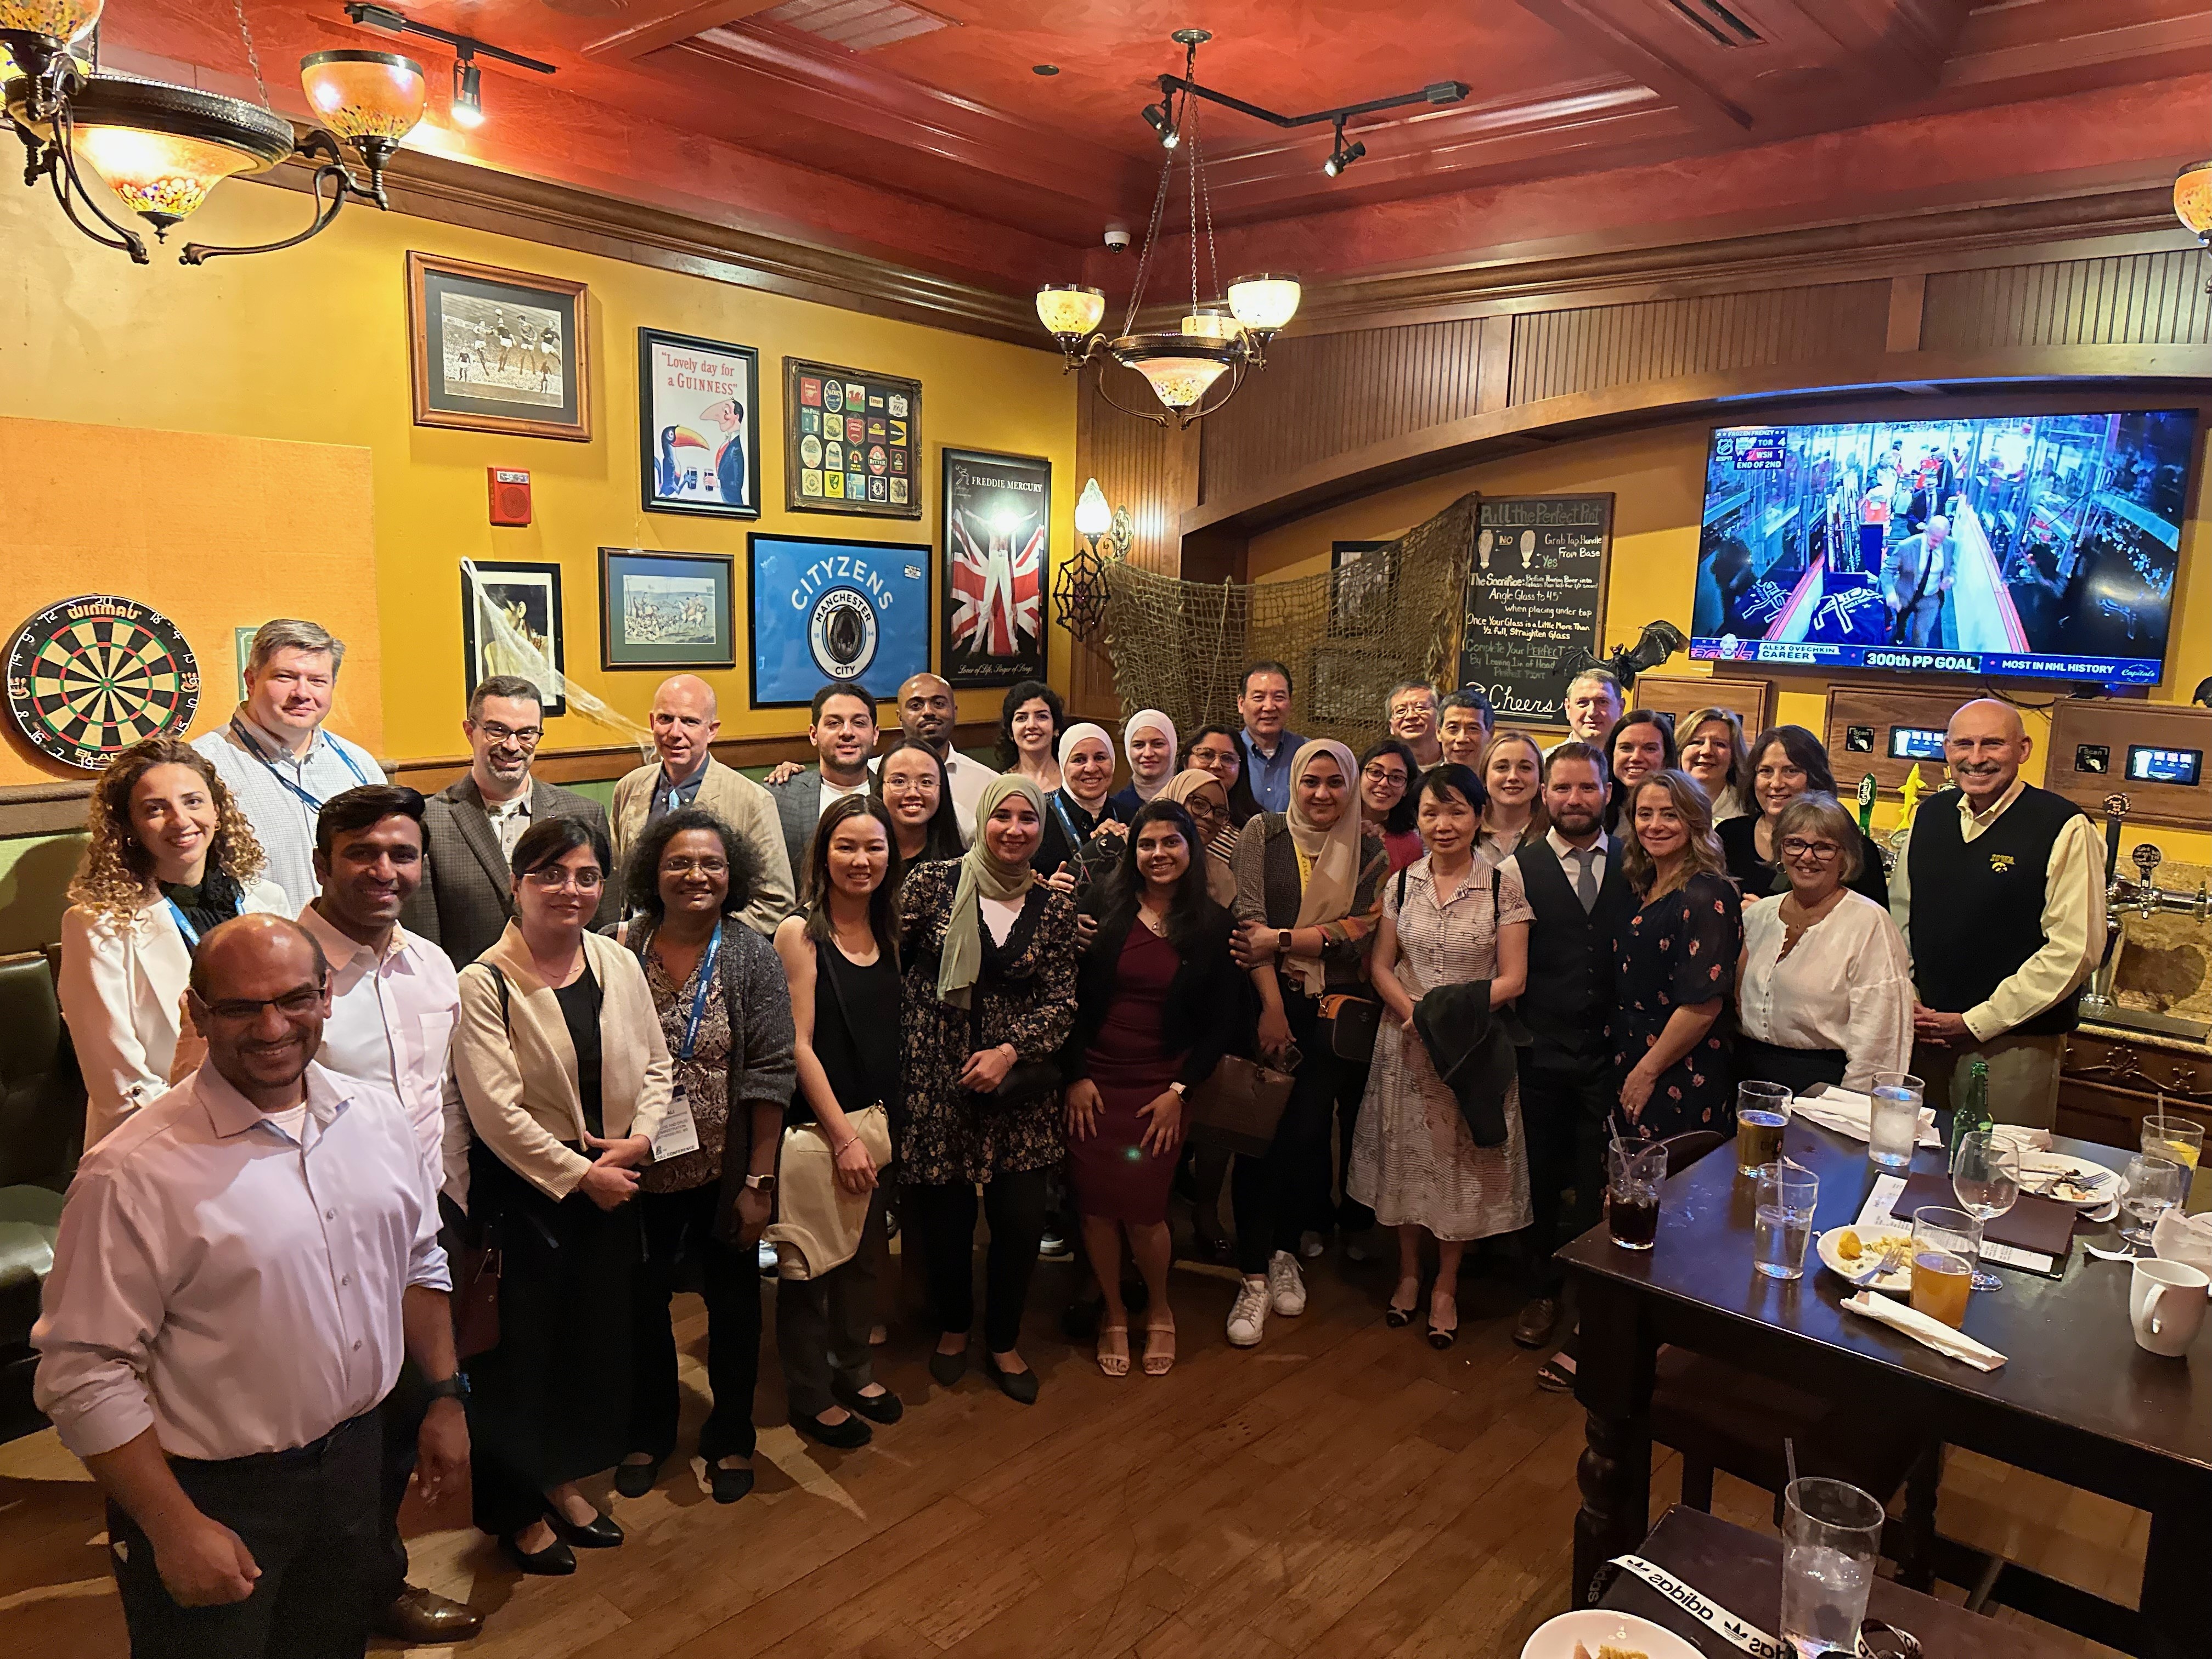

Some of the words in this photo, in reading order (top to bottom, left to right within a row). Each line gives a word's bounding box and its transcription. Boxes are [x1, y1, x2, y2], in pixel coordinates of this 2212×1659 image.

[701, 360, 718, 376] day
[721, 363, 735, 376] for
[668, 377, 674, 387] a
[1778, 437, 1786, 447] 4
[1778, 449, 1784, 459] 1
[972, 476, 1005, 488] FREDDIE
[1007, 480, 1042, 493] MERCURY
[1511, 504, 1536, 523] the
[1536, 503, 1579, 523] Perfect
[1499, 535, 1513, 544] NO
[1545, 533, 1565, 545] Grab
[1566, 533, 1579, 546] Tap
[1580, 534, 1602, 544] Handle
[1559, 547, 1577, 558] From
[1579, 547, 1601, 558] Base
[1543, 555, 1558, 567] Yes
[791, 556, 894, 610] CITYZENS
[1488, 588, 1514, 605] Angle
[1514, 589, 1536, 602] Glass
[1537, 591, 1545, 601] to
[815, 593, 871, 623] MANCHESTER
[1505, 603, 1527, 613] when
[1528, 605, 1555, 619] placing
[1555, 607, 1577, 616] under
[1578, 608, 1593, 618] tap
[150, 612, 163, 624] 18
[1467, 613, 1487, 625] Once
[1488, 616, 1503, 627] Your
[1504, 617, 1523, 628] Glass
[1525, 620, 1531, 628] is
[1537, 620, 1555, 629] Little
[1555, 622, 1573, 631] More
[1573, 623, 1590, 631] Than
[173, 630, 182, 640] 4
[1509, 628, 1546, 641] Straighten
[1548, 631, 1571, 640] Glass
[1466, 639, 1504, 657] Complete
[1506, 642, 1525, 657] Your
[1470, 653, 1481, 668] By
[1525, 658, 1534, 668] of
[1536, 657, 1555, 669] Head
[1762, 651, 1809, 659] CAREER
[1866, 652, 1910, 667] 300th
[1912, 655, 1933, 668] PP
[1934, 657, 1975, 670] GOAL
[2002, 660, 2031, 669] MOST
[2032, 661, 2044, 670] IN
[2045, 662, 2066, 671] NHL
[2067, 663, 2115, 674] HISTORY
[2121, 668, 2155, 678] Capitals
[835, 665, 856, 675] CITY
[185, 698, 198, 709] 10
[1489, 684, 1563, 713] Cheers
[2084, 748, 2103, 756] Scan
[1990, 854, 2015, 865] IOWA
